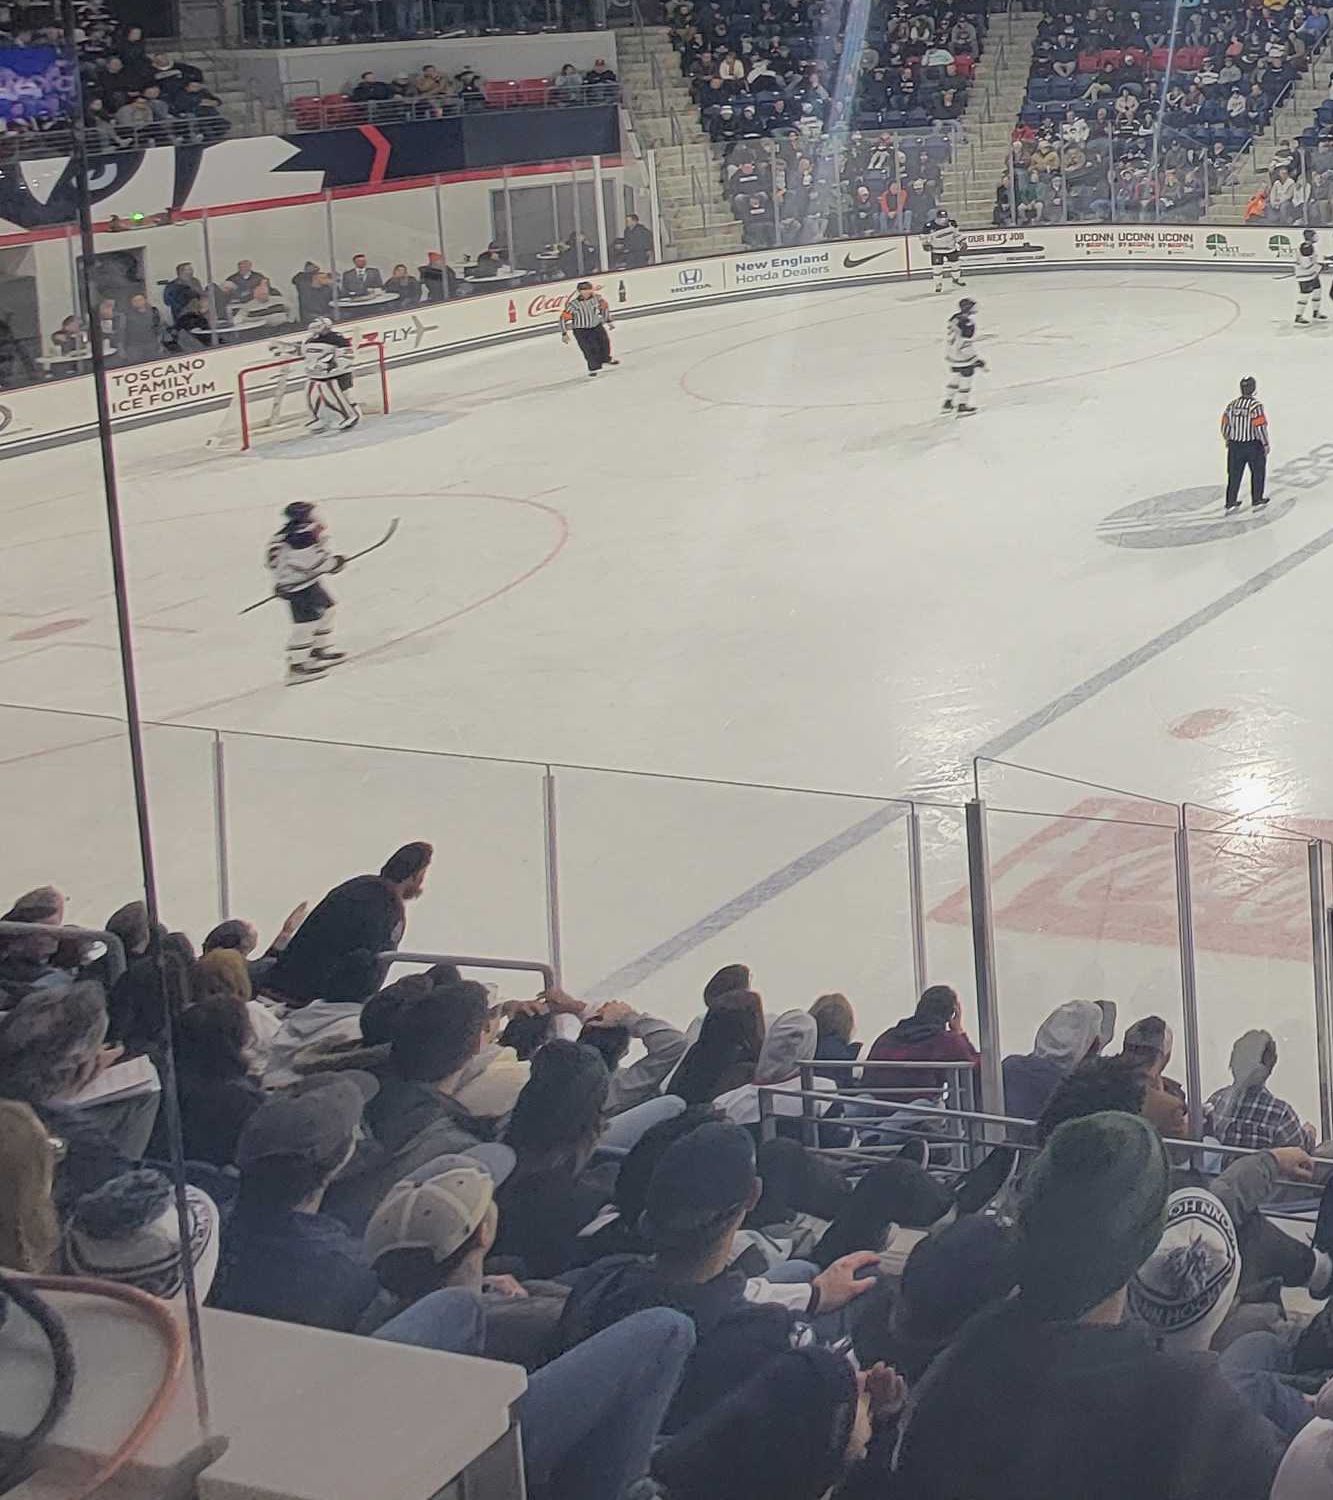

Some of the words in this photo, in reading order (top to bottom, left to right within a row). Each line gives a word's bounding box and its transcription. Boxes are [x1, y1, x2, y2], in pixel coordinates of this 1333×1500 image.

[1075, 233, 1114, 242] UCONN
[1118, 233, 1154, 242] UCONN
[1158, 233, 1193, 242] UCONN
[735, 261, 769, 273] New
[771, 252, 829, 269] England
[736, 270, 779, 285] Honda
[782, 264, 830, 278] Dealers
[383, 327, 410, 344] FLY
[112, 358, 206, 386] TOSCANO
[128, 373, 194, 397] FAMILY
[112, 397, 143, 413] ICE
[150, 382, 216, 406] FORUM
